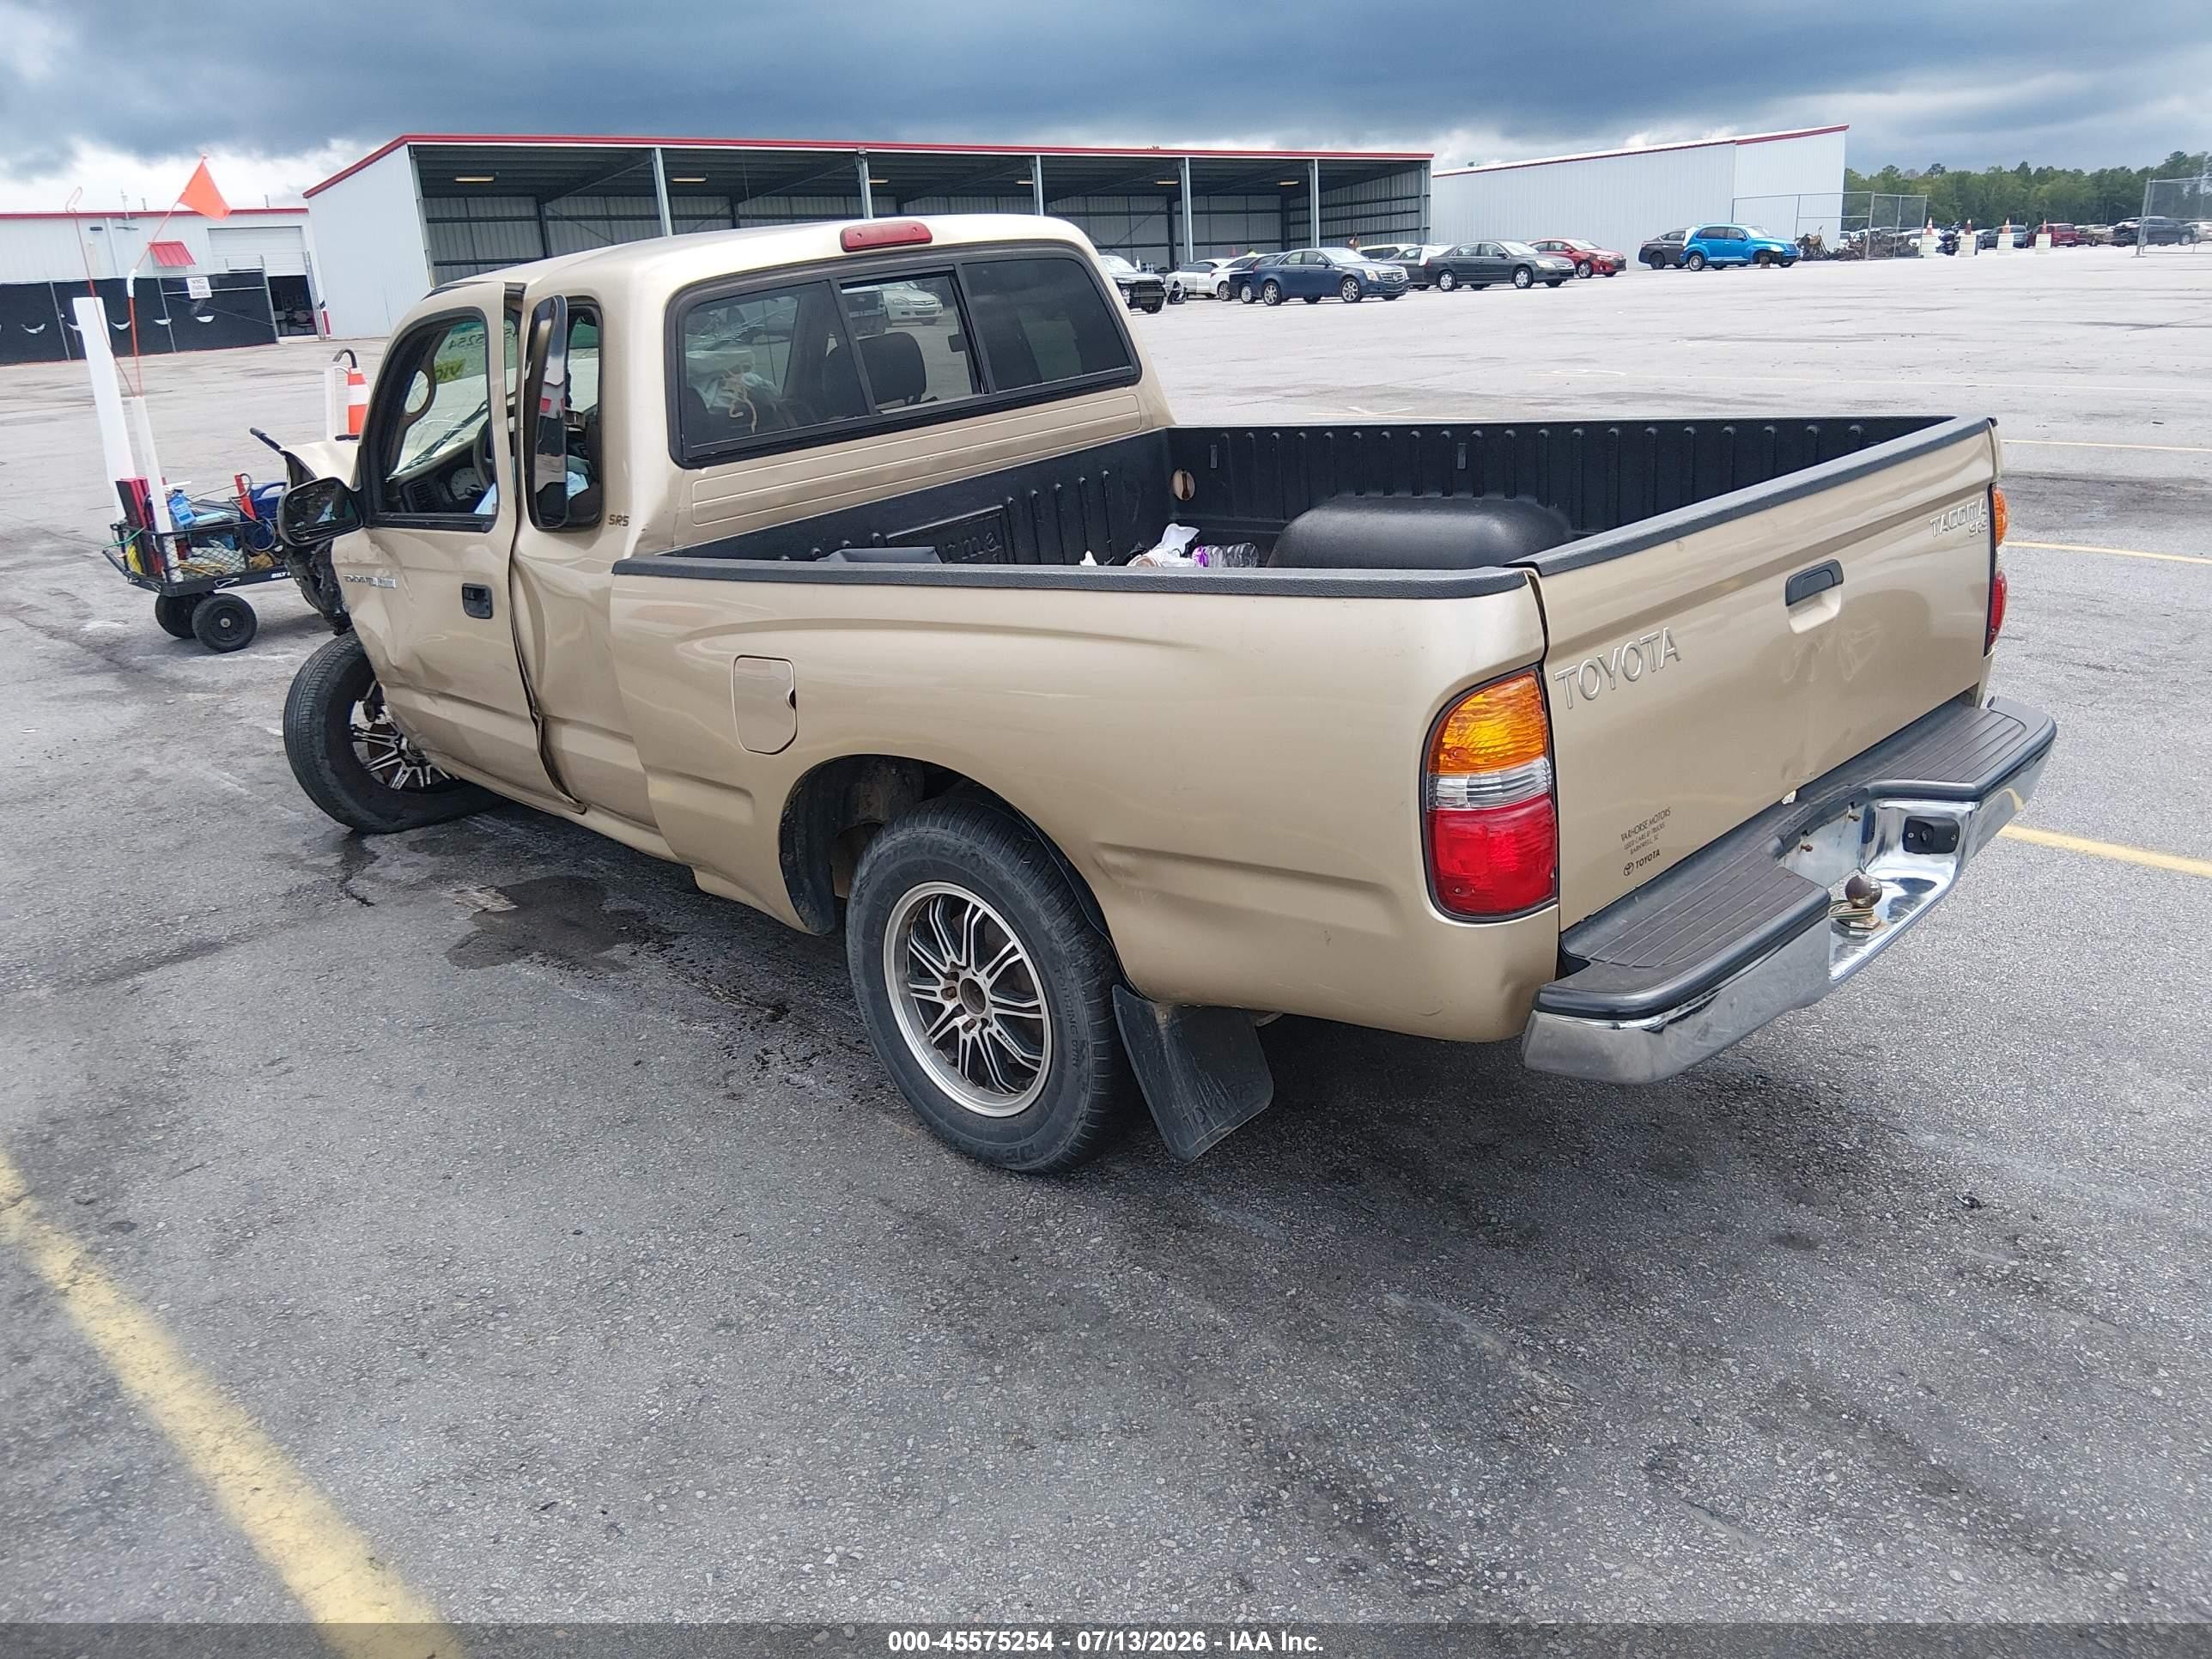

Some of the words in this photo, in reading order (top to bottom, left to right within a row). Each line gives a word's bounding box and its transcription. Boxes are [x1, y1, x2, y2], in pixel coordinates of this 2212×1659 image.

[1929, 498, 1988, 537] TACOMA
[1553, 627, 1682, 709] TOYOTA
[1636, 849, 1661, 869] TOYOTA
